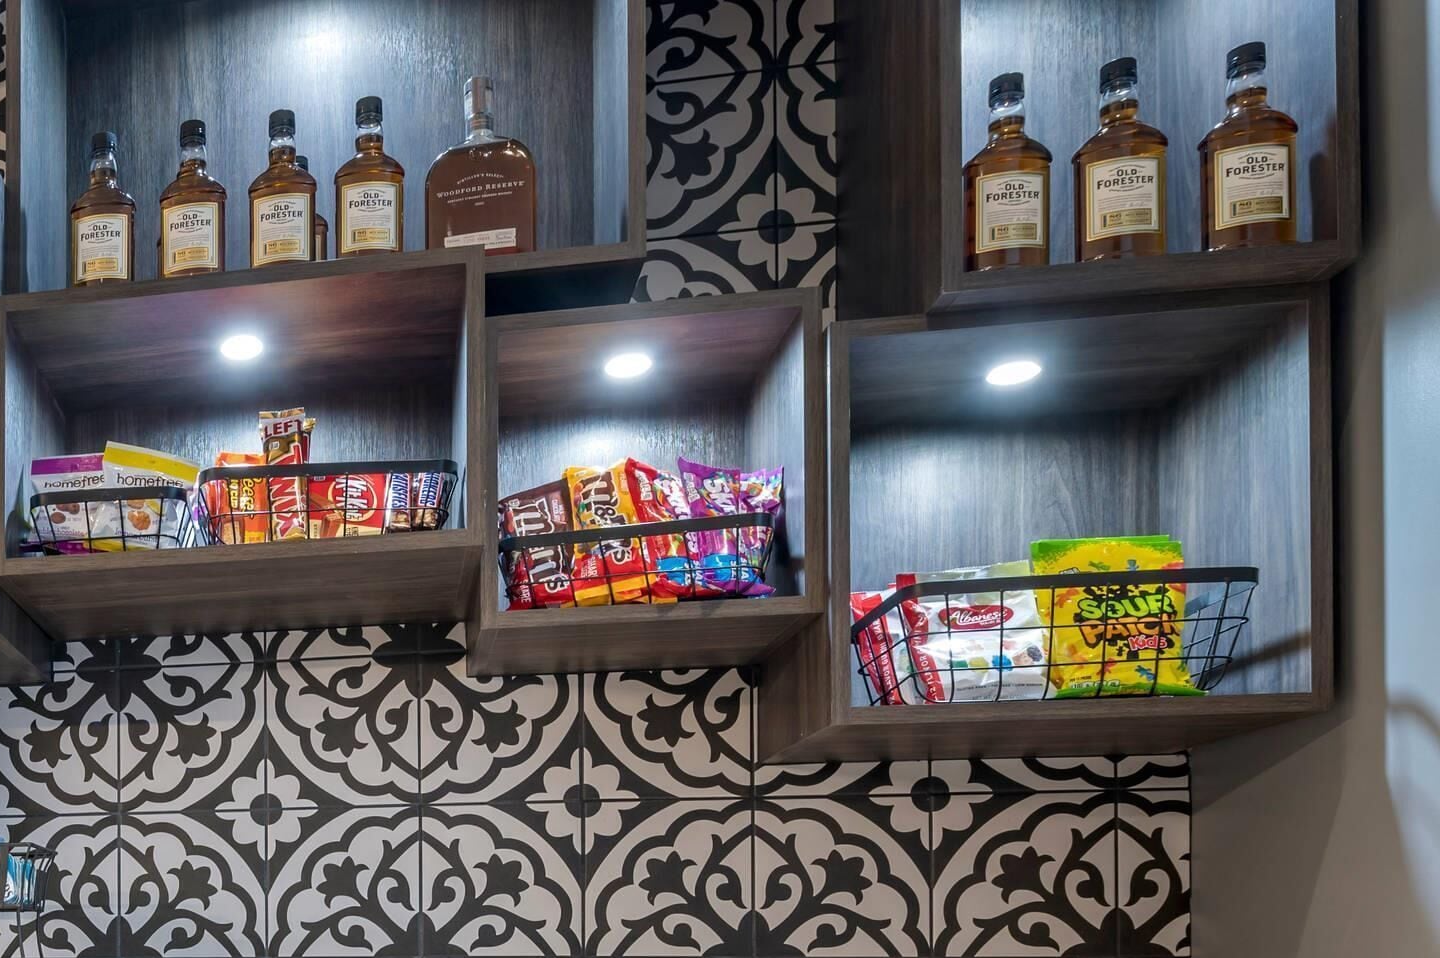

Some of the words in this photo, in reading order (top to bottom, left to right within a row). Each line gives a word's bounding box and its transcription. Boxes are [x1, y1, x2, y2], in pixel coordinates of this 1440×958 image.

[1246, 156, 1268, 164] OLD
[1116, 168, 1137, 177] OLD
[1226, 163, 1285, 177] FORESTER
[437, 185, 483, 198] WOODFORD
[486, 180, 525, 190] RESERVE
[1004, 183, 1025, 191] OLD
[1096, 176, 1154, 190] FORESTER
[986, 191, 1040, 203] FORESTER
[349, 199, 393, 208] FORESTER
[182, 213, 197, 221] OLD
[260, 210, 304, 222] FORESTER
[93, 224, 108, 232] OLD
[170, 218, 211, 231] FORESTER
[80, 230, 121, 241] FORESTER
[264, 420, 302, 437] LEFT
[1078, 594, 1174, 620] SOUR
[1127, 635, 1168, 651] Kids
